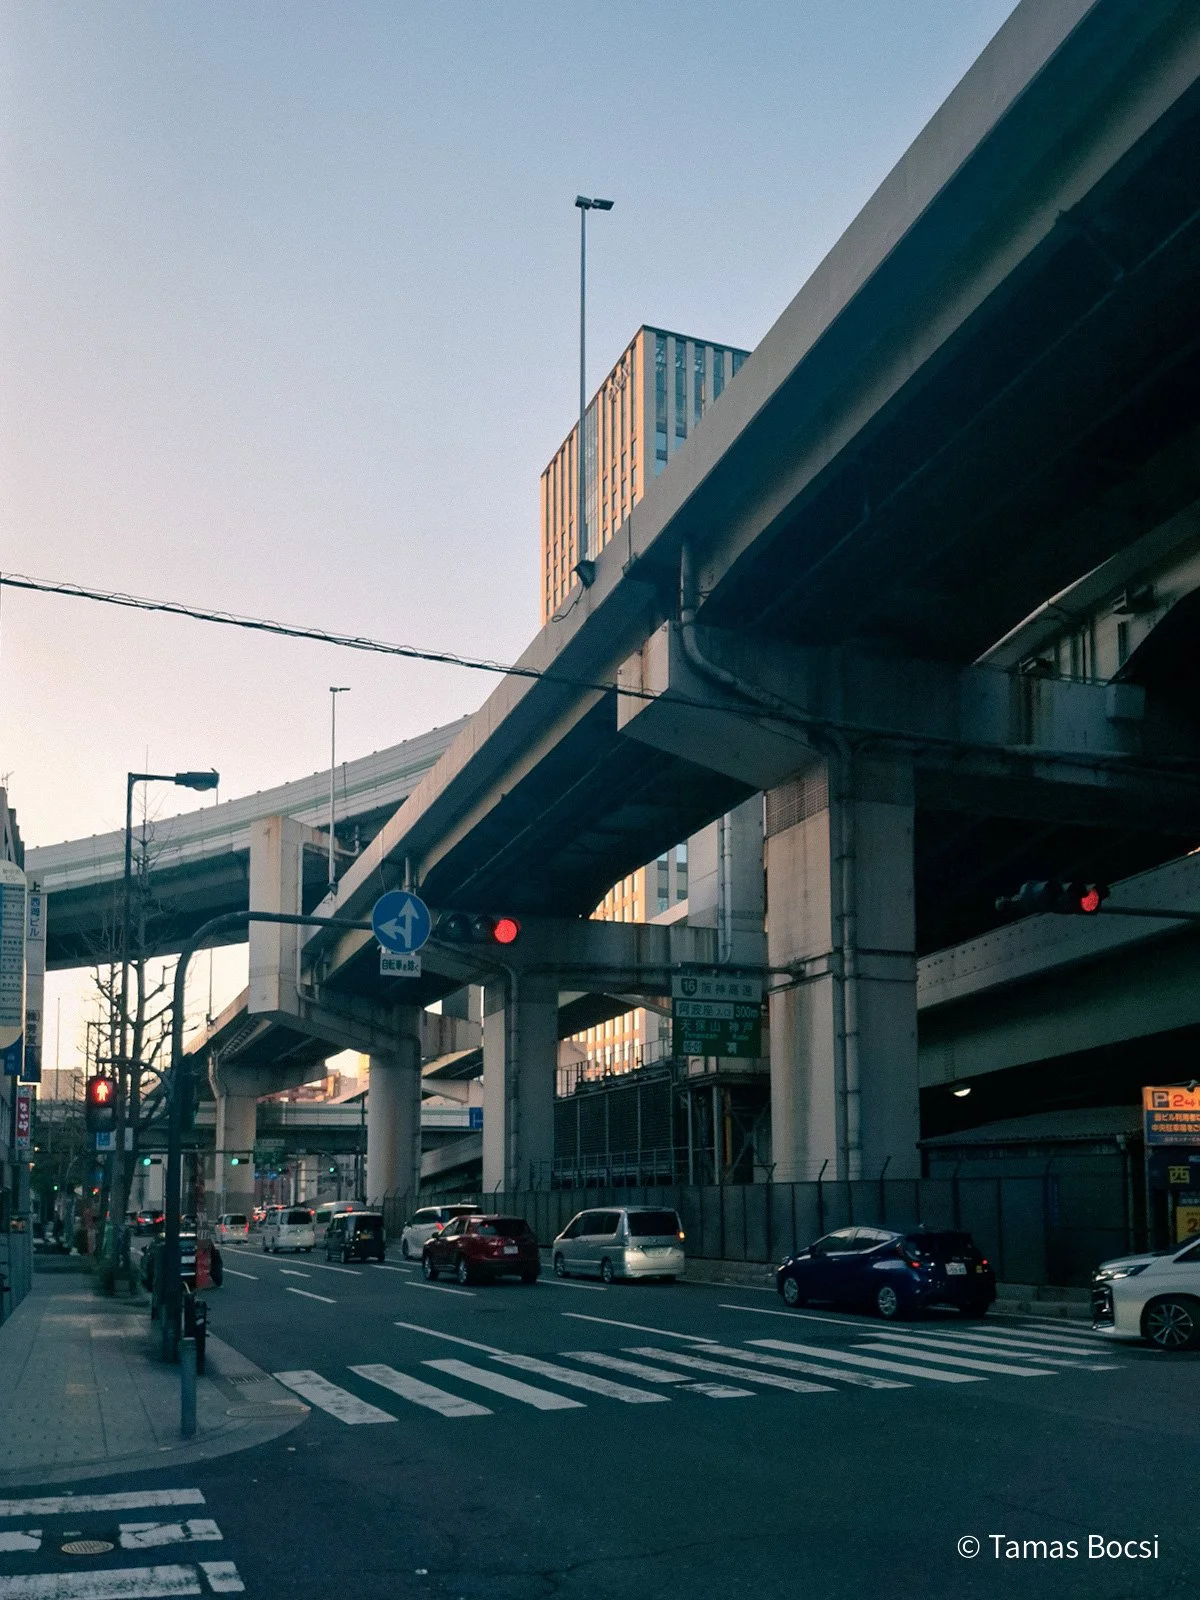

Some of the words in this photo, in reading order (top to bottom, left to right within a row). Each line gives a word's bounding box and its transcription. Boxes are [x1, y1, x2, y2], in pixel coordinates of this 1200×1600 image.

[683, 980, 695, 992] 16
[702, 982, 753, 997] 阪神高速
[1154, 1092, 1169, 1107] P
